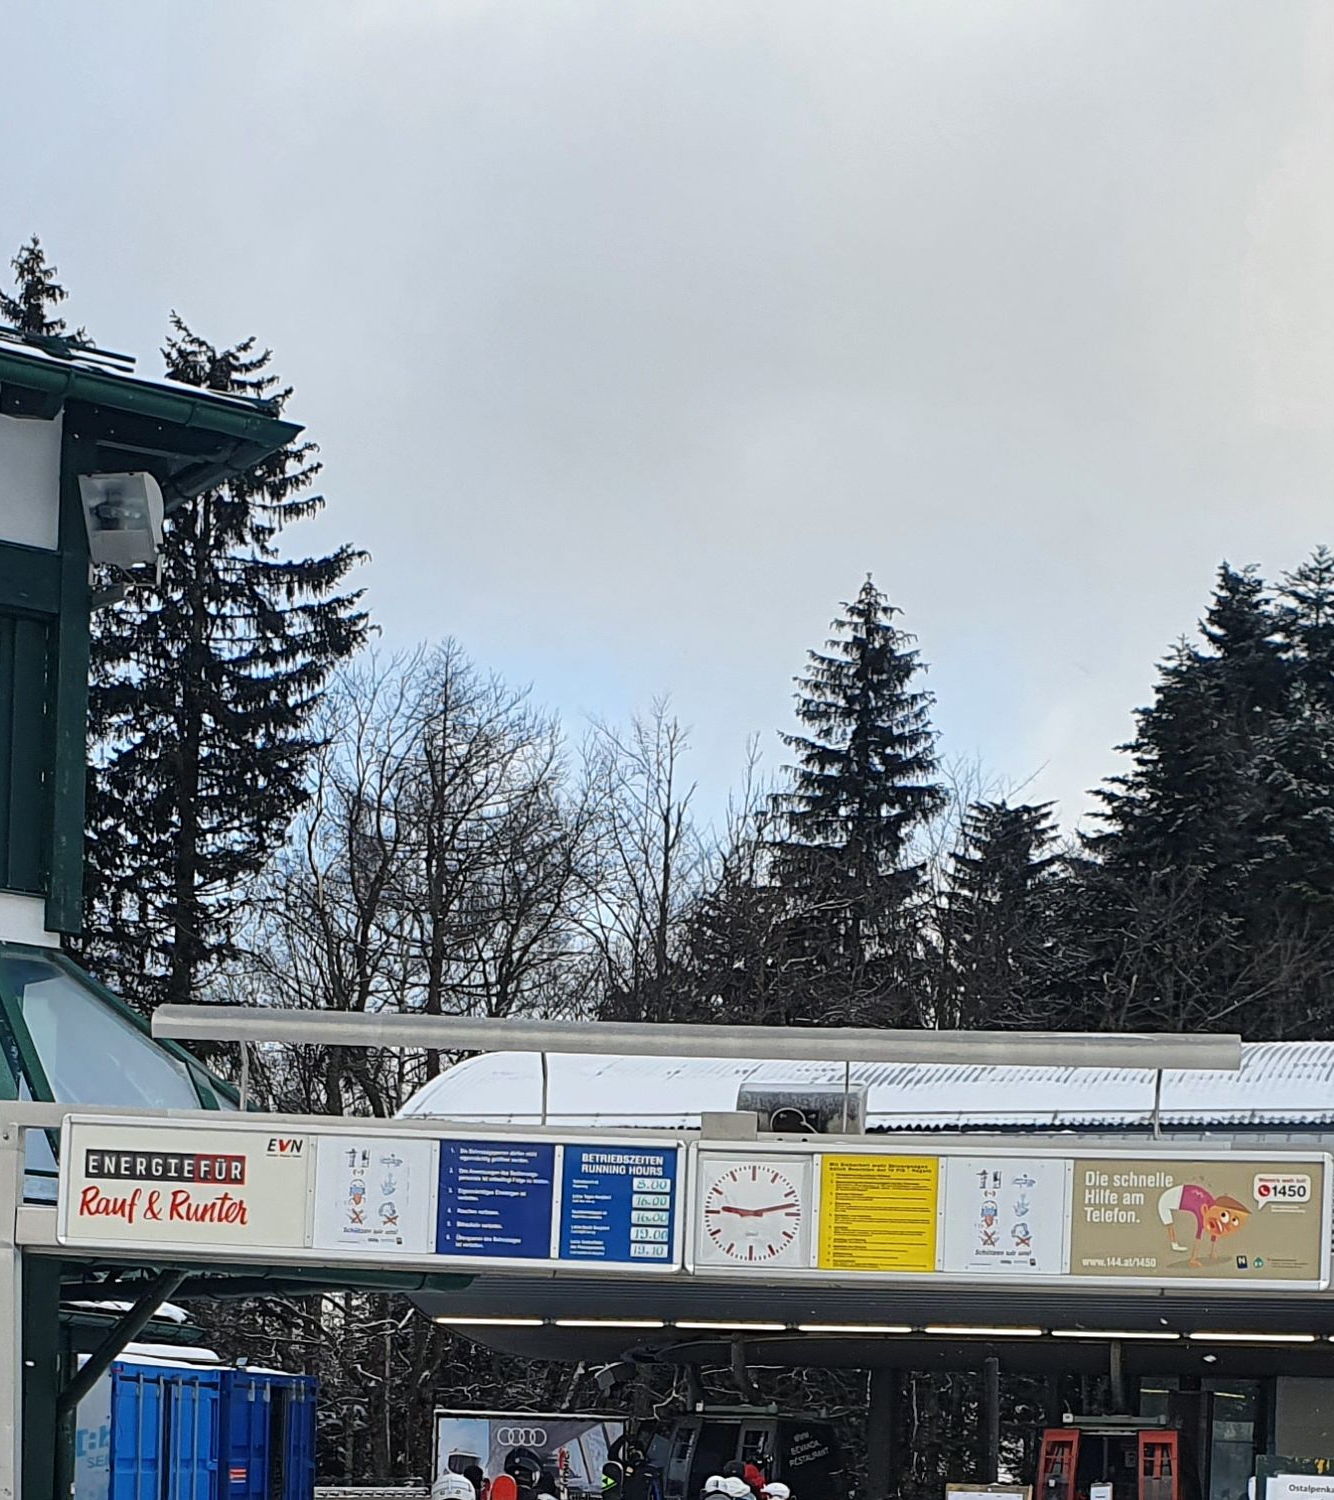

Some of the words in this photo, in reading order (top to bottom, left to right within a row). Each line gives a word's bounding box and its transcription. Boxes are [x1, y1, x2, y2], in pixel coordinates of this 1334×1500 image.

[267, 1138, 303, 1153] EVN
[581, 1153, 664, 1166] BETRIEBSZEITEN
[581, 1164, 626, 1174] RUNNING
[628, 1166, 663, 1176] HOURS
[1085, 1171, 1108, 1186] Die
[1113, 1171, 1173, 1187] schnelle
[1085, 1189, 1118, 1204] Hilfe
[1122, 1192, 1144, 1205] am
[1272, 1185, 1307, 1197] 1450
[79, 1186, 142, 1224] Rauf
[143, 1190, 163, 1220] &
[169, 1189, 248, 1225] Runter
[1084, 1207, 1141, 1223] Telefon.
[1082, 1257, 1157, 1267] www.144.at/1450
